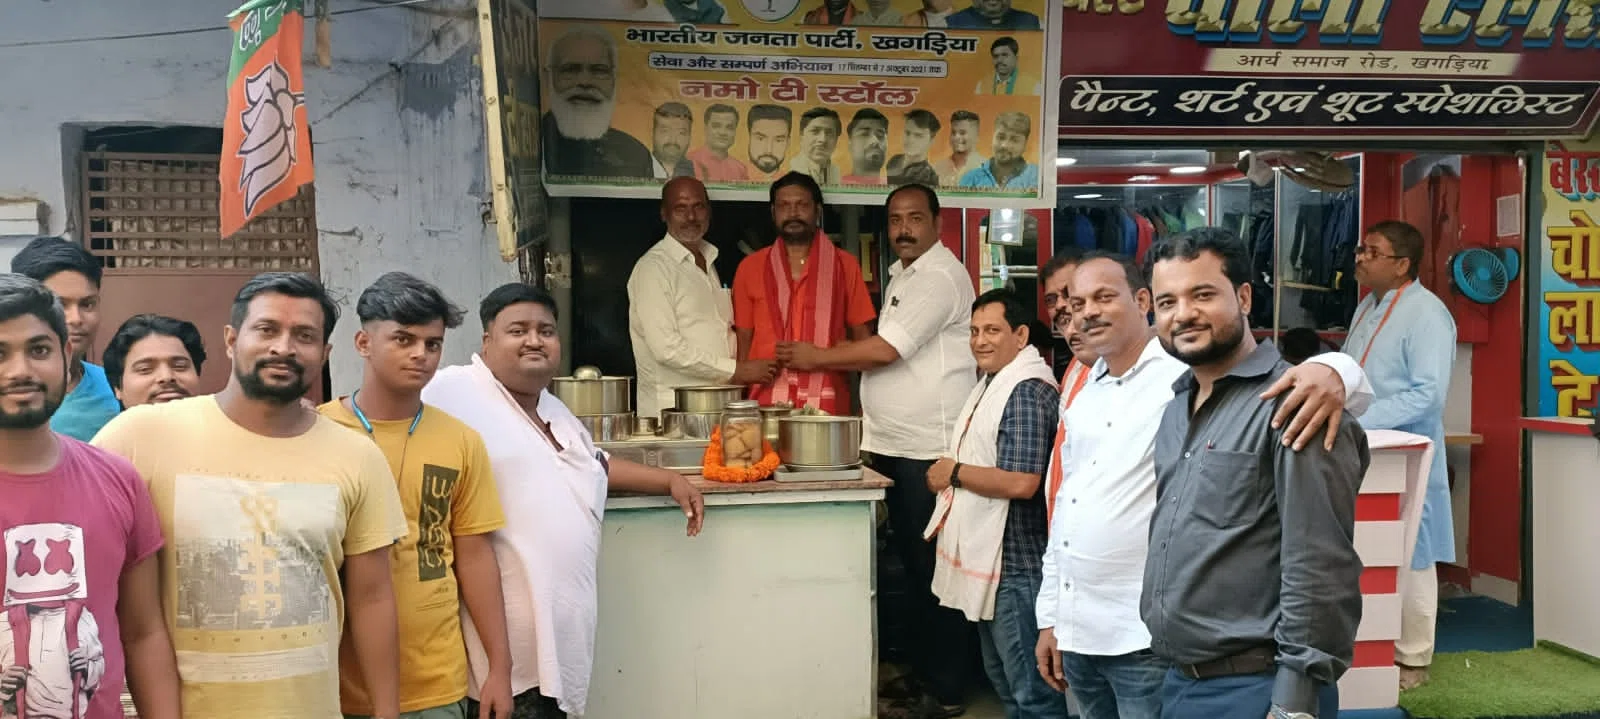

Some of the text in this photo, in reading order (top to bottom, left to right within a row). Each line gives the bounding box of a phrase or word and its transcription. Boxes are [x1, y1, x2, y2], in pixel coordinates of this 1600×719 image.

[626, 24, 718, 45] भारतीय
[723, 31, 799, 47] जनता
[872, 33, 978, 55] खगड़िया
[652, 55, 682, 67] सेवा
[687, 56, 717, 69] और
[770, 58, 833, 73] अभियान
[1237, 51, 1281, 67] आर्य
[1292, 55, 1350, 68] समाज
[1411, 55, 1490, 73] खगड़िया
[680, 77, 918, 104] नमो टी स्टॉल
[1174, 82, 1257, 113] शर्ट
[1245, 84, 1326, 123] एवं
[1321, 90, 1393, 122] शूट
